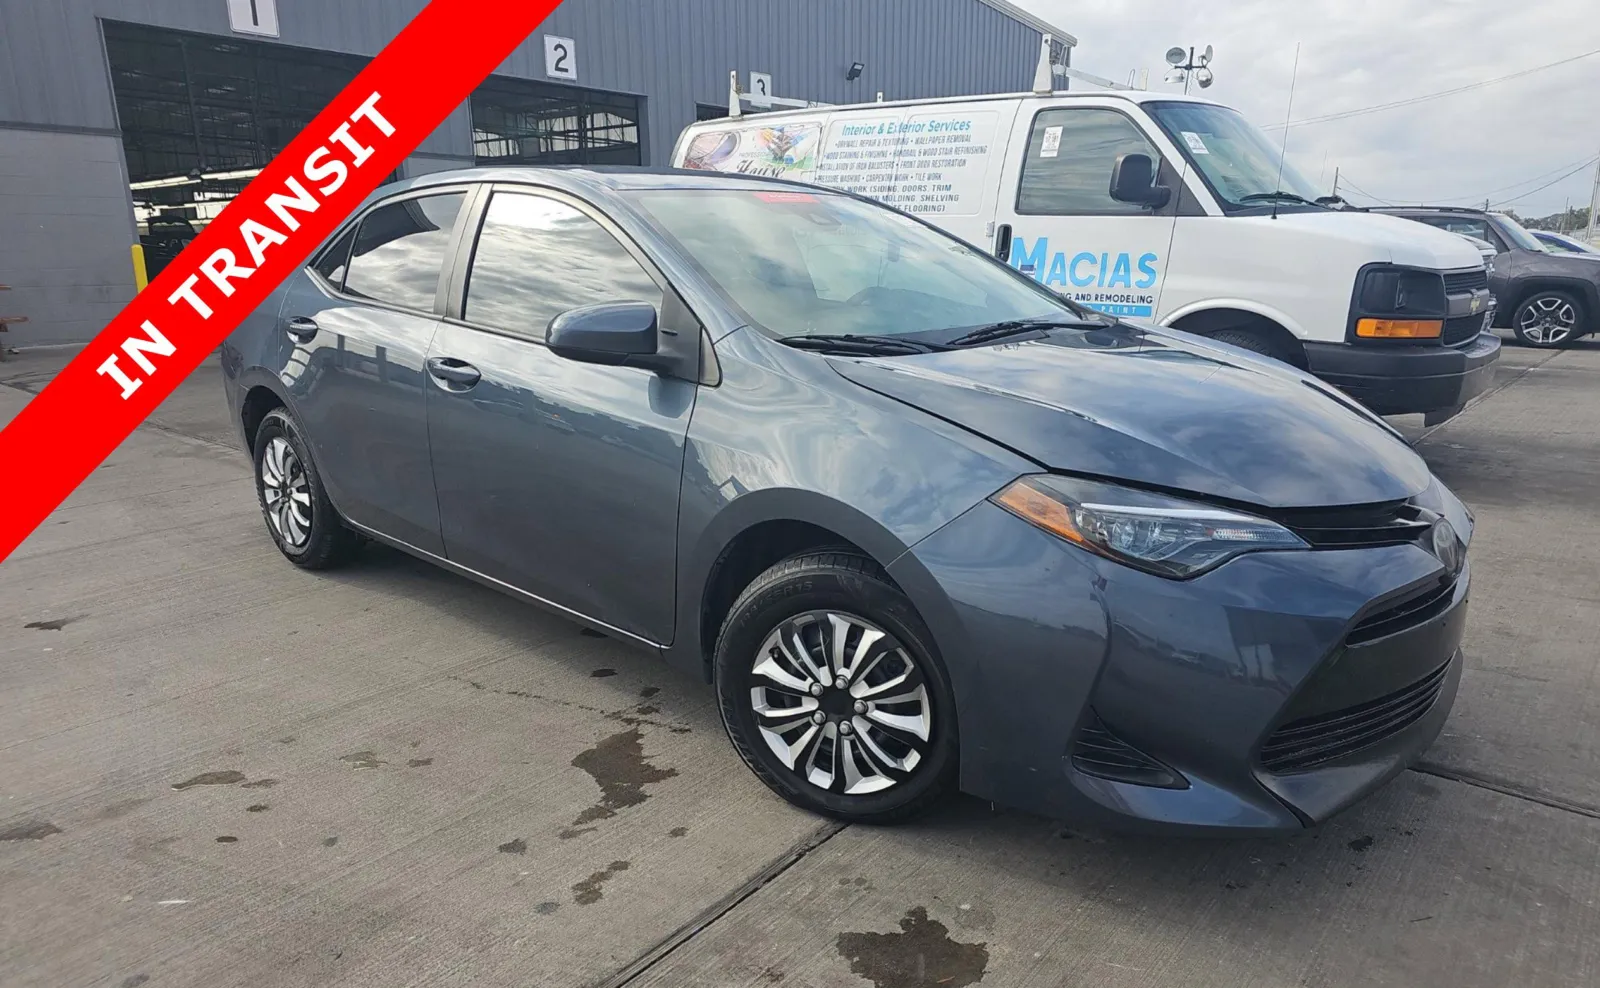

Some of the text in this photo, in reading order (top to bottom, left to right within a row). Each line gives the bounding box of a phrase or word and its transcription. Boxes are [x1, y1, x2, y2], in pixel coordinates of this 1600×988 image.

[553, 43, 569, 73] 2
[757, 78, 766, 96] 3
[842, 119, 971, 136] Interior & Exterior Services
[859, 139, 877, 147] REPAIR
[915, 135, 945, 145] WALLPAPER
[946, 134, 971, 143] REMOVAL
[923, 147, 938, 156] WOOD
[938, 147, 954, 156] STAIR
[954, 145, 987, 155] REFINISHING
[868, 160, 895, 170] BALUSTERS
[900, 160, 917, 169] FRONT
[917, 159, 931, 168] DOOR
[931, 158, 967, 168] RESTORATION
[895, 172, 909, 181] WORK
[915, 172, 926, 181] TILE
[927, 171, 942, 181] WORK
[847, 185, 868, 193] WORK
[920, 194, 960, 202] SHELVING
[904, 204, 946, 212] FLOORING)
[1010, 237, 1158, 289] MACIAS
[1075, 292, 1092, 301] AND
[1095, 293, 1153, 304] REMODELING
[1101, 305, 1136, 314] PAINT
